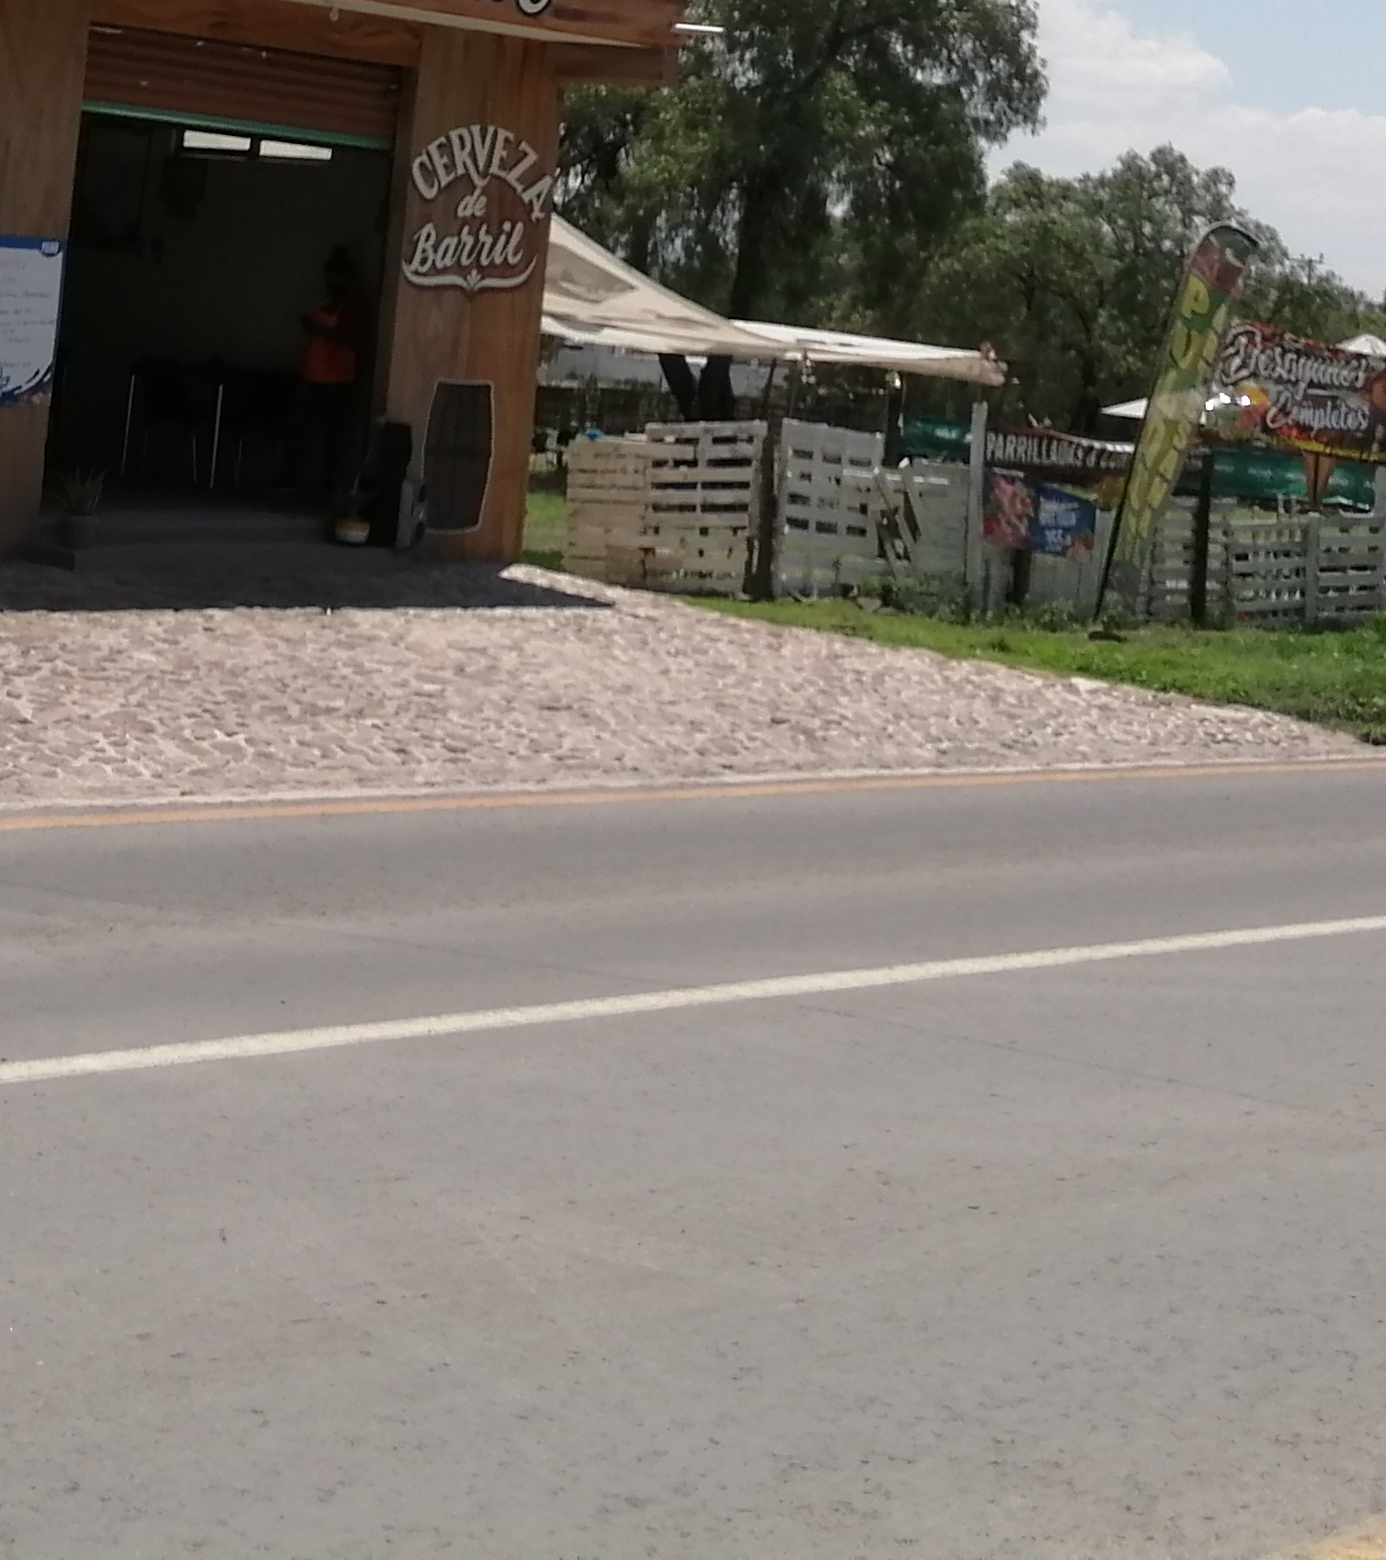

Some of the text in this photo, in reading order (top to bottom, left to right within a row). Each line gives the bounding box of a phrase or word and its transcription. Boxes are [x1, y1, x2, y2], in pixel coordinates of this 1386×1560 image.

[412, 124, 553, 220] CERVEZA
[456, 180, 487, 219] de
[411, 220, 524, 272] Barril
